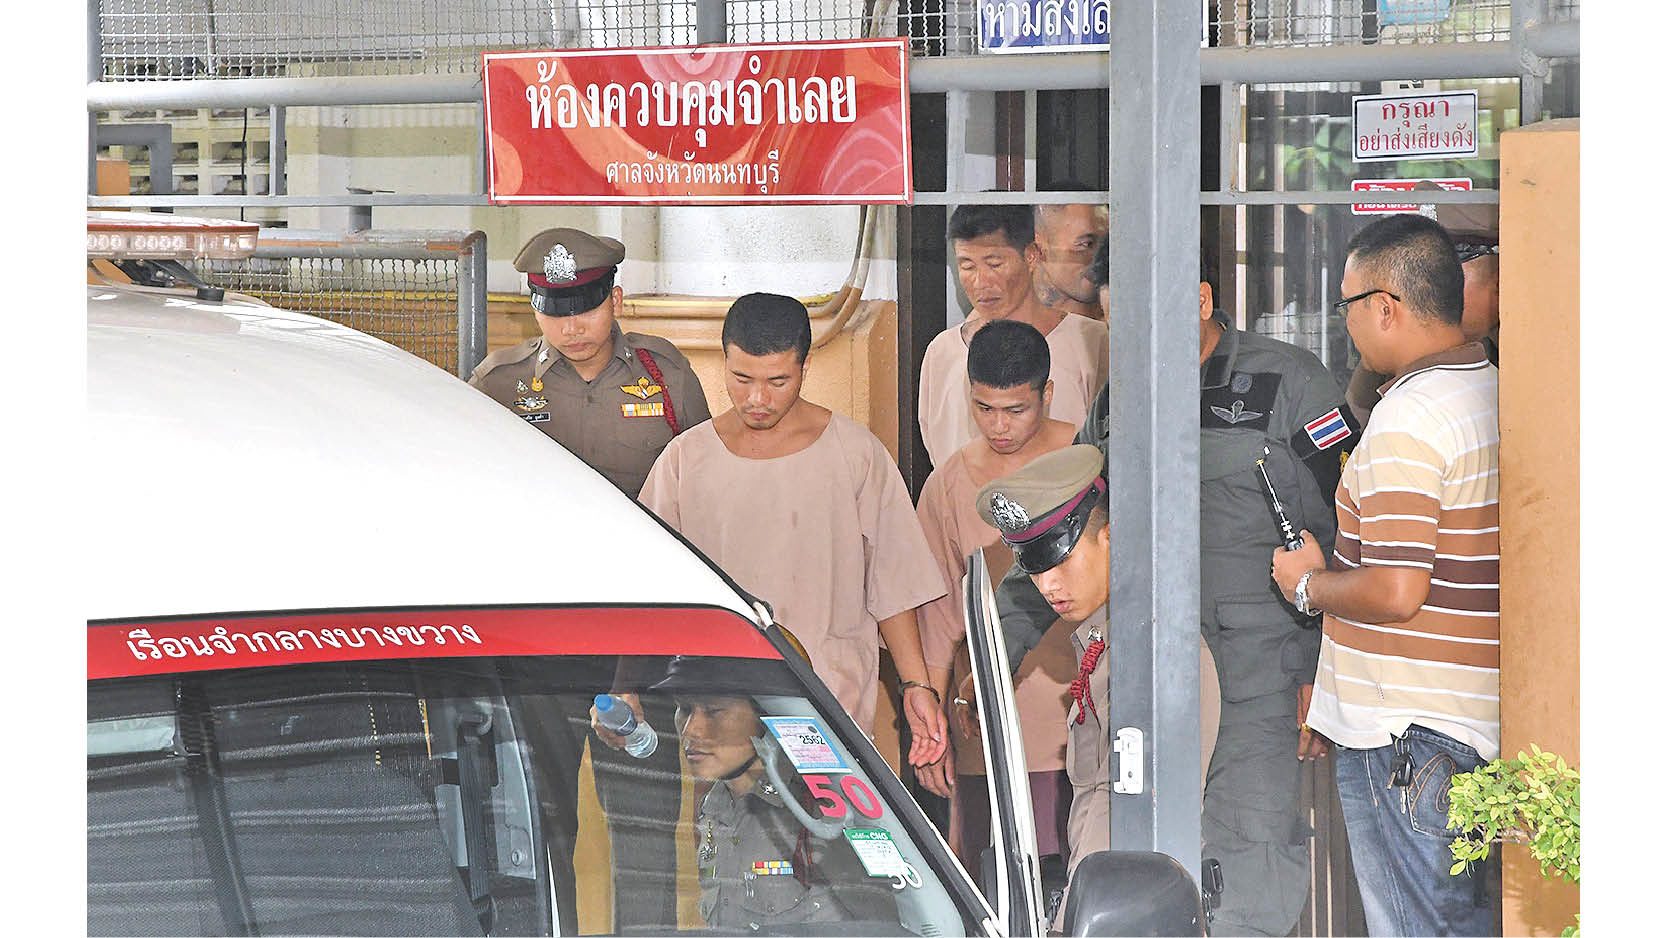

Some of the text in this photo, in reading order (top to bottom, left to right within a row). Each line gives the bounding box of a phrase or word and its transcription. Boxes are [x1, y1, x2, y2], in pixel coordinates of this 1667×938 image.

[525, 55, 858, 148] ห้องควบคุมจำเลย
[1382, 100, 1450, 128] กรุณา
[1360, 122, 1473, 151] อย่าส่งเสียงดัง
[606, 149, 780, 193] ศาลจังหวัดนนทบุรี
[126, 623, 482, 661] เรือนจำกลางบางขวาง
[799, 735, 826, 745] 2562
[802, 775, 883, 819] 50
